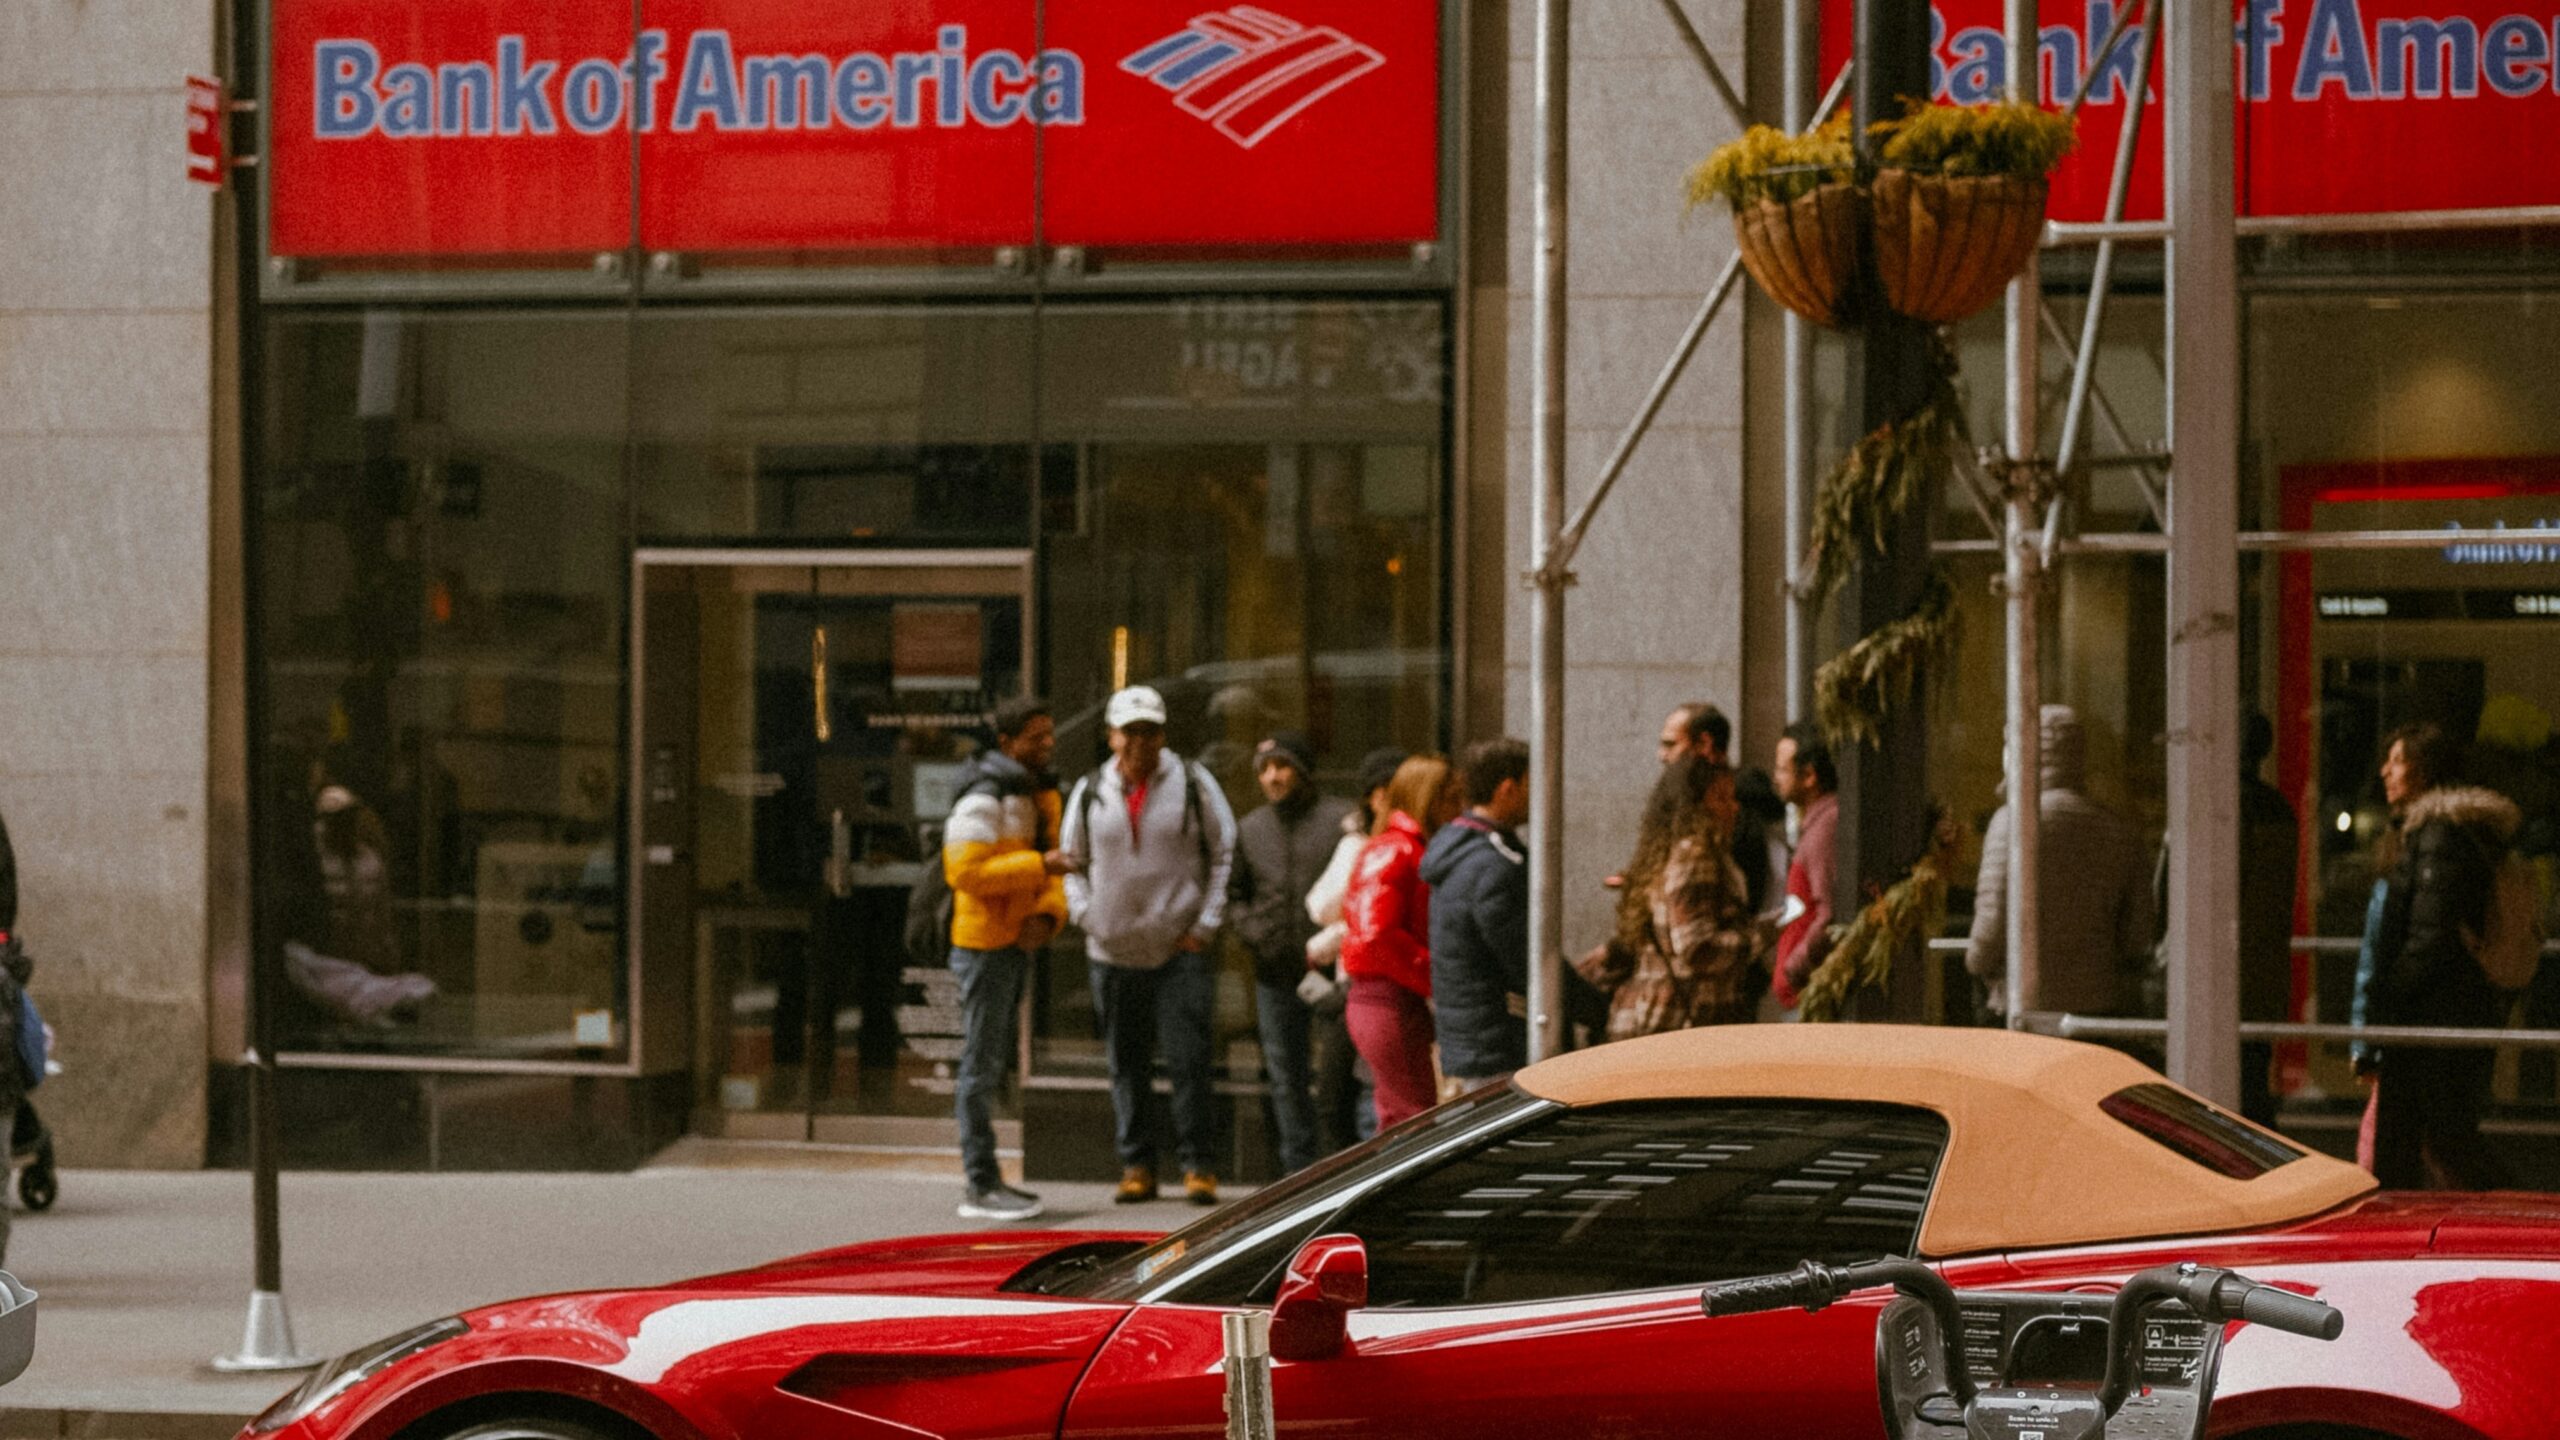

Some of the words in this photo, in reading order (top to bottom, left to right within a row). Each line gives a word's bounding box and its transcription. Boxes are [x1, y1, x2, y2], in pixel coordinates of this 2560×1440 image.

[314, 34, 559, 139] Bank
[563, 29, 667, 135] of
[671, 24, 1085, 131] America
[1930, 0, 2156, 104] ank
[2235, 0, 2284, 102] f
[2291, 0, 2560, 101] Ame
